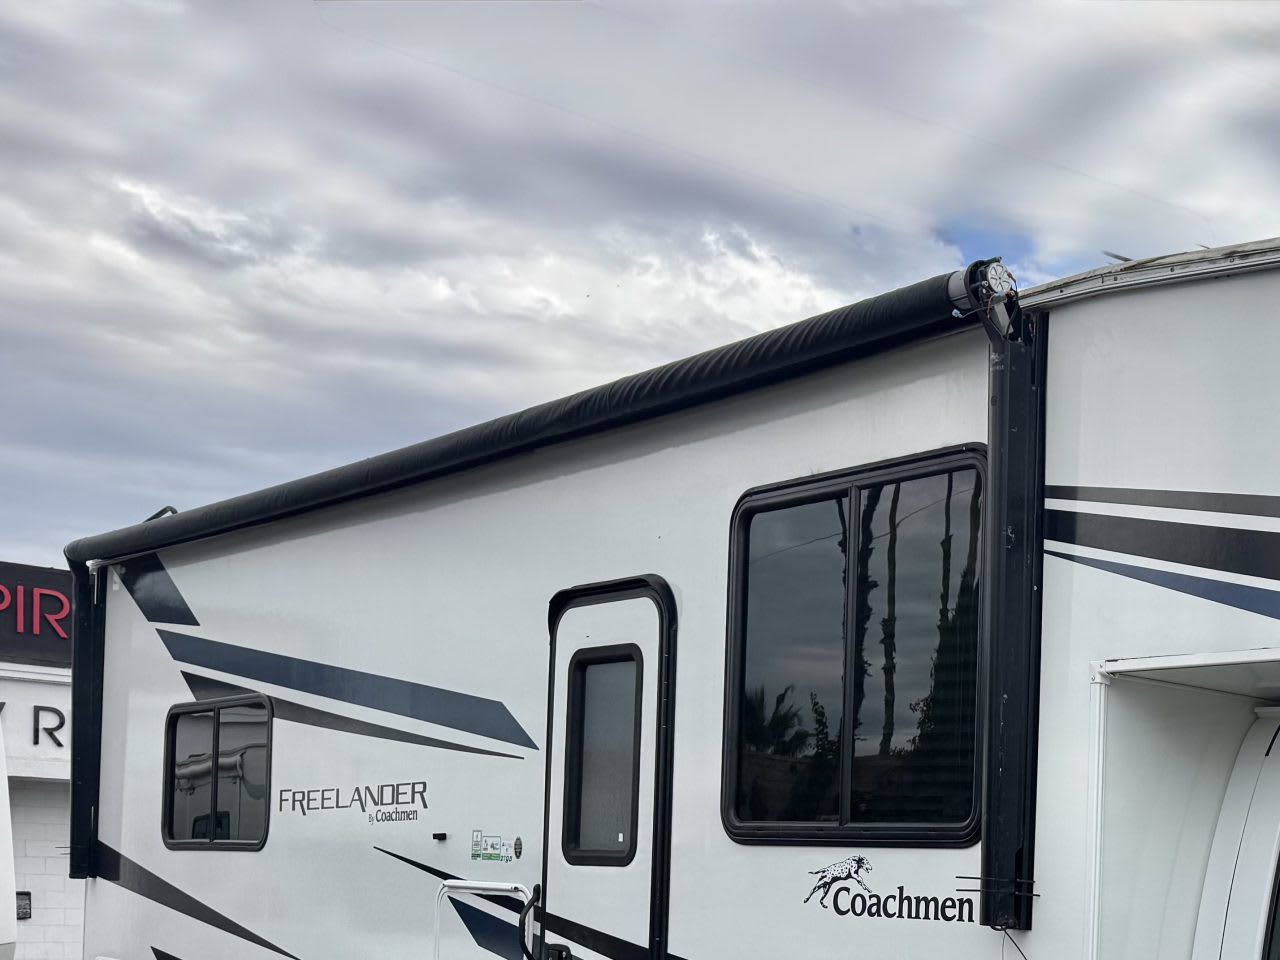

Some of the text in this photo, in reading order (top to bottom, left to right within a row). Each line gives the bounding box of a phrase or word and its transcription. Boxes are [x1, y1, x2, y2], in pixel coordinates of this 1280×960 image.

[279, 781, 429, 816] FREELANDER
[375, 807, 418, 823] Coachmen
[833, 886, 975, 923] Coachmen
